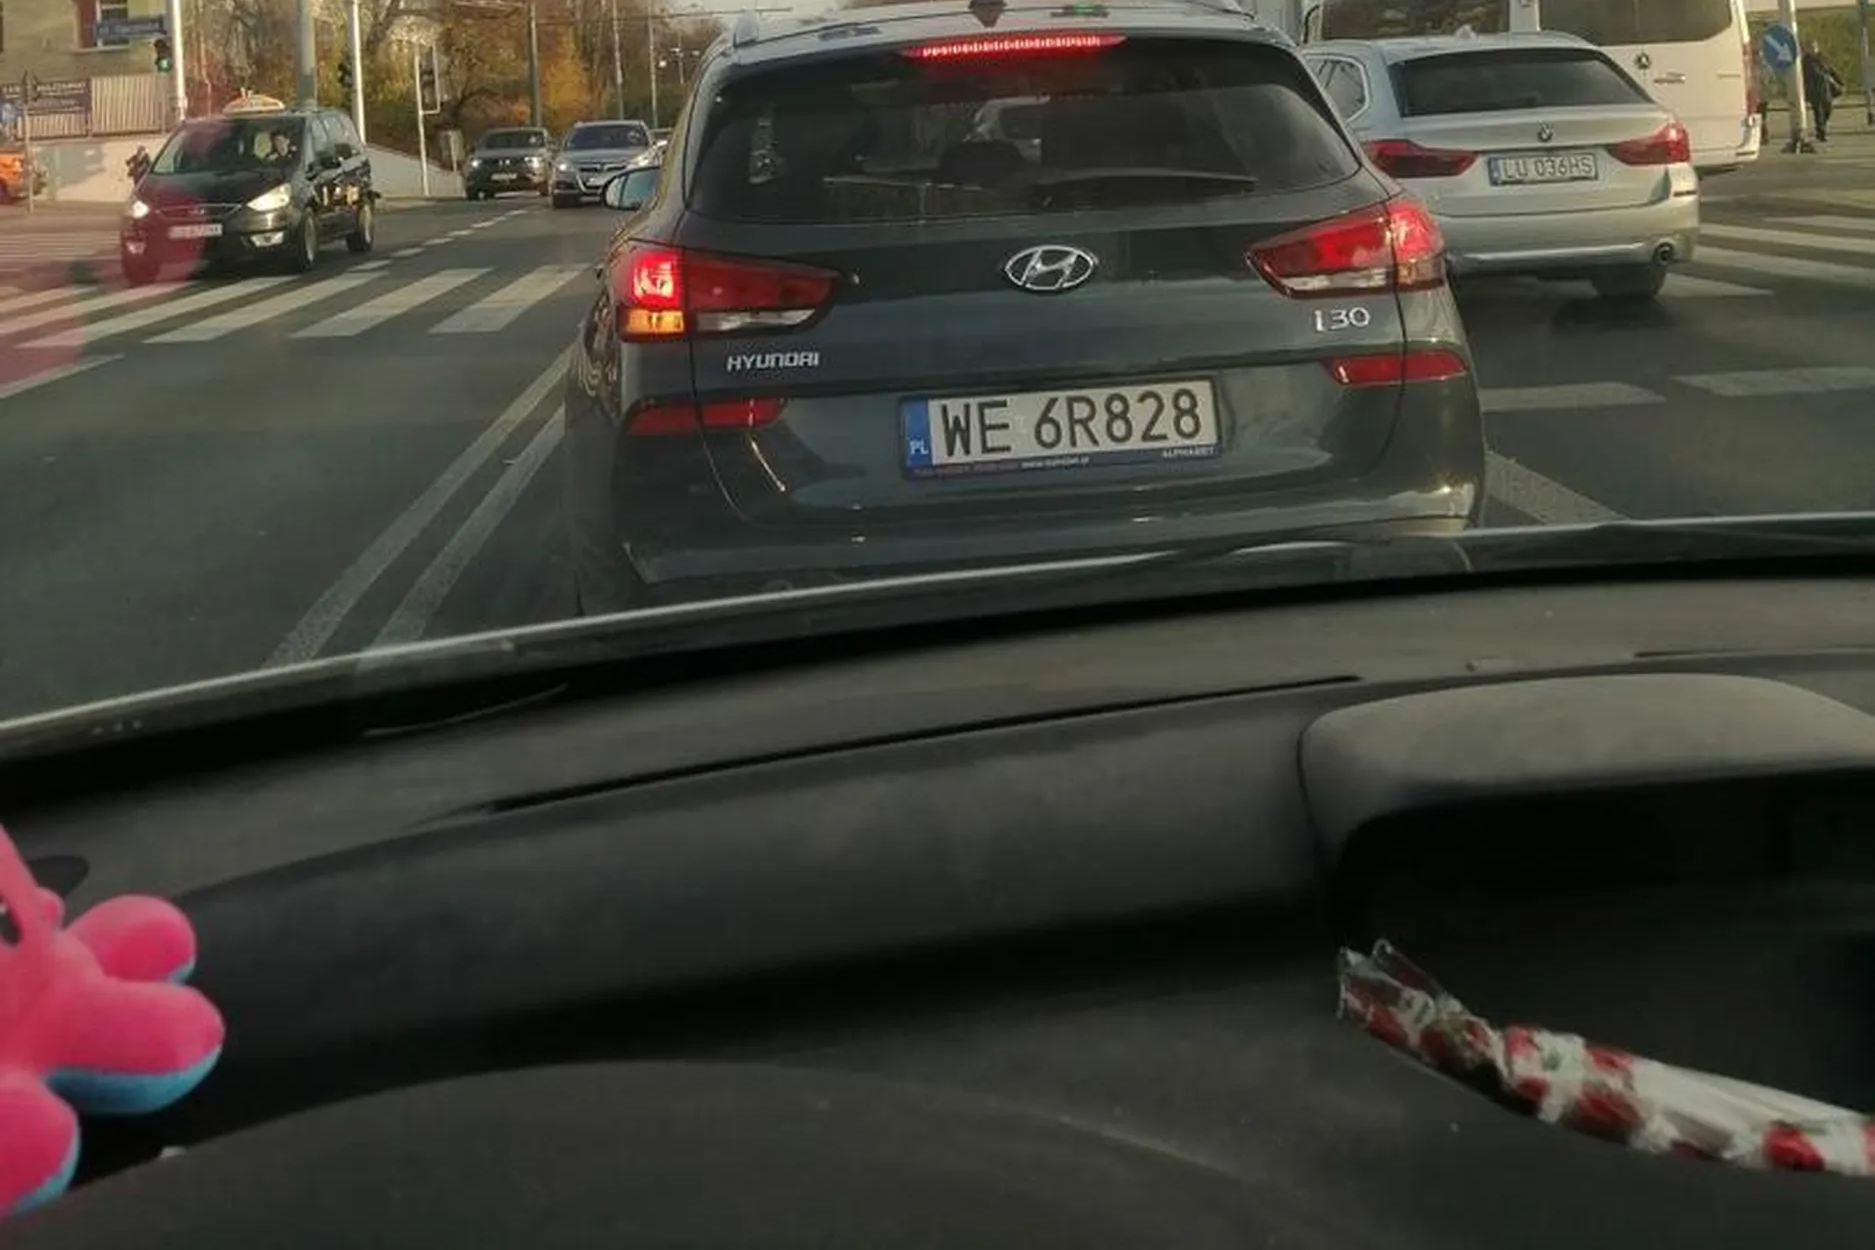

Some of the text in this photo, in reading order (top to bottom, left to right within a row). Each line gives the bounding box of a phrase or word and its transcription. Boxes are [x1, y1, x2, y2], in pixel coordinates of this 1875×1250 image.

[1503, 157, 1594, 178] LU 036HS
[726, 351, 820, 372] HYUNDAI
[940, 387, 1203, 457] WE 6R828
[909, 439, 929, 455] PL
